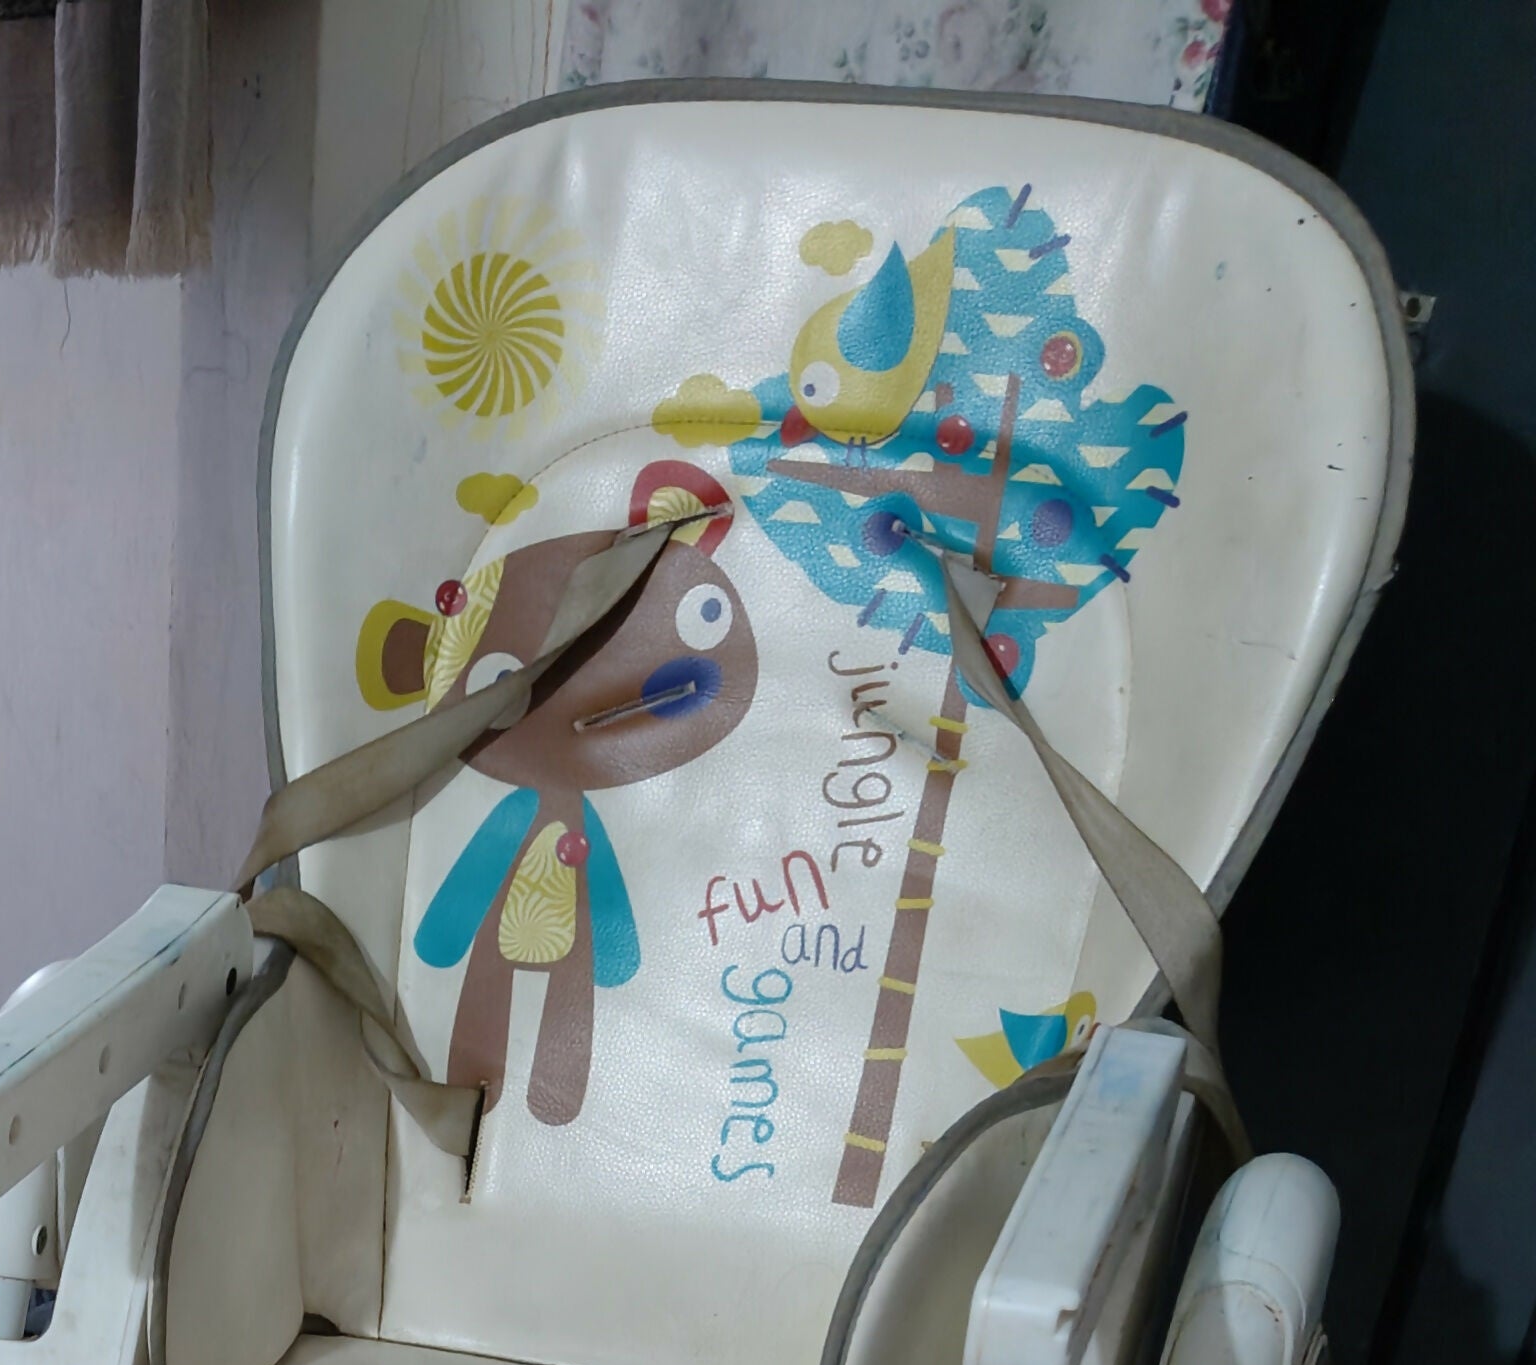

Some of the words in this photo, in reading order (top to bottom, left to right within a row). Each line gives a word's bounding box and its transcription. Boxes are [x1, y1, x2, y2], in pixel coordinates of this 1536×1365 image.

[822, 650, 904, 872] jungle
[698, 849, 830, 945] fun
[780, 923, 868, 973] and
[711, 964, 793, 1183] games
